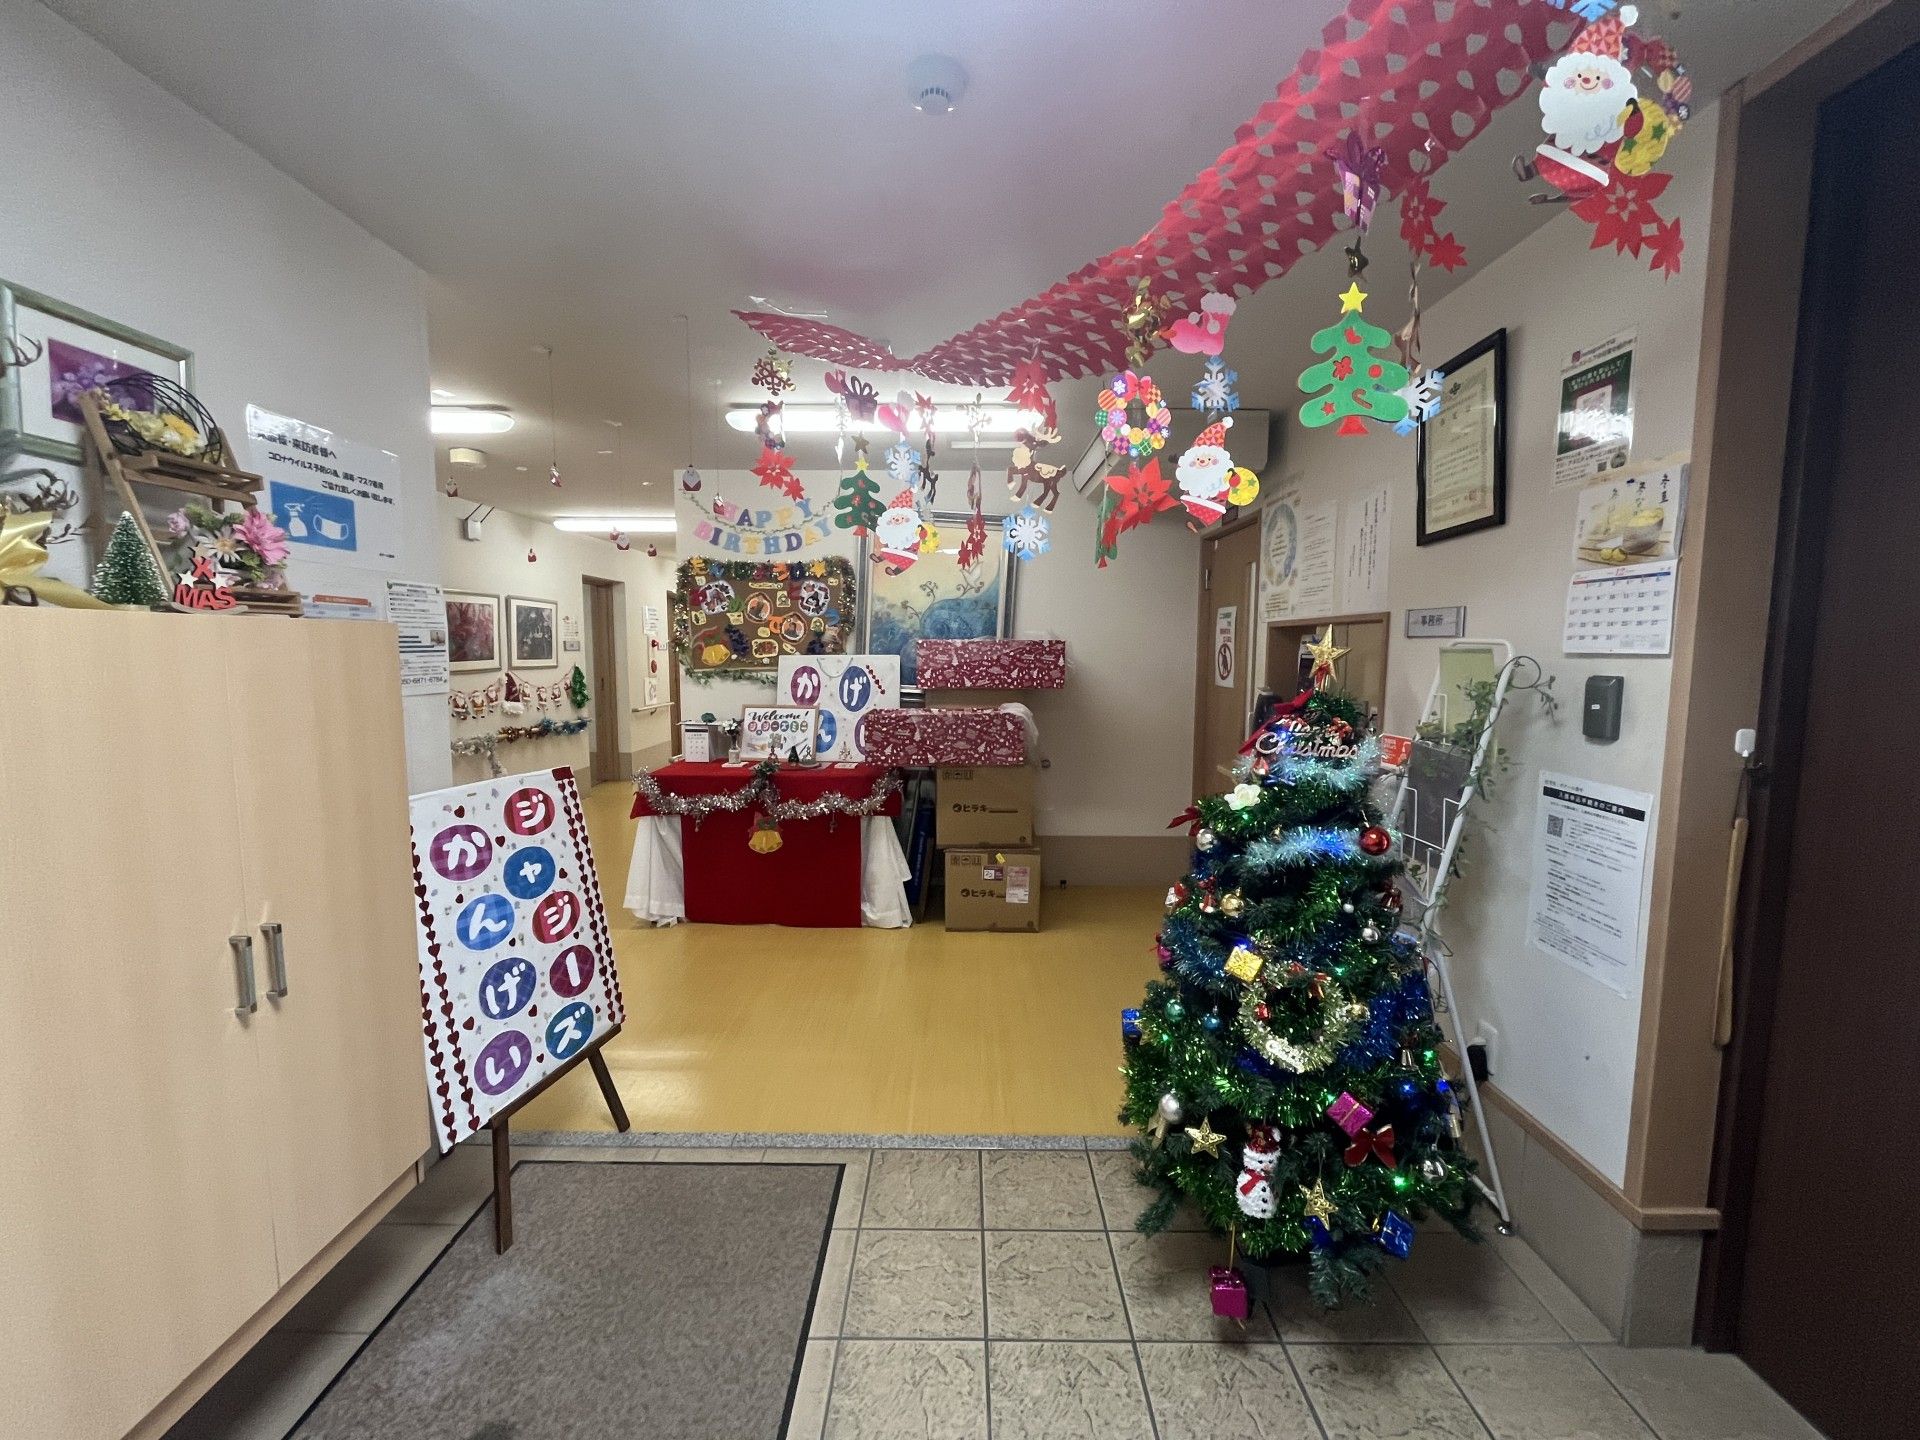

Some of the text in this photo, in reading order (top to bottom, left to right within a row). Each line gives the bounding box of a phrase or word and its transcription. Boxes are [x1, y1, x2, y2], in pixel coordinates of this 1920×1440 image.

[694, 517, 832, 555] BIRTHDAY
[174, 584, 237, 610] MAS
[963, 803, 987, 813] ヒラキ
[971, 889, 996, 898] ヒラキ
